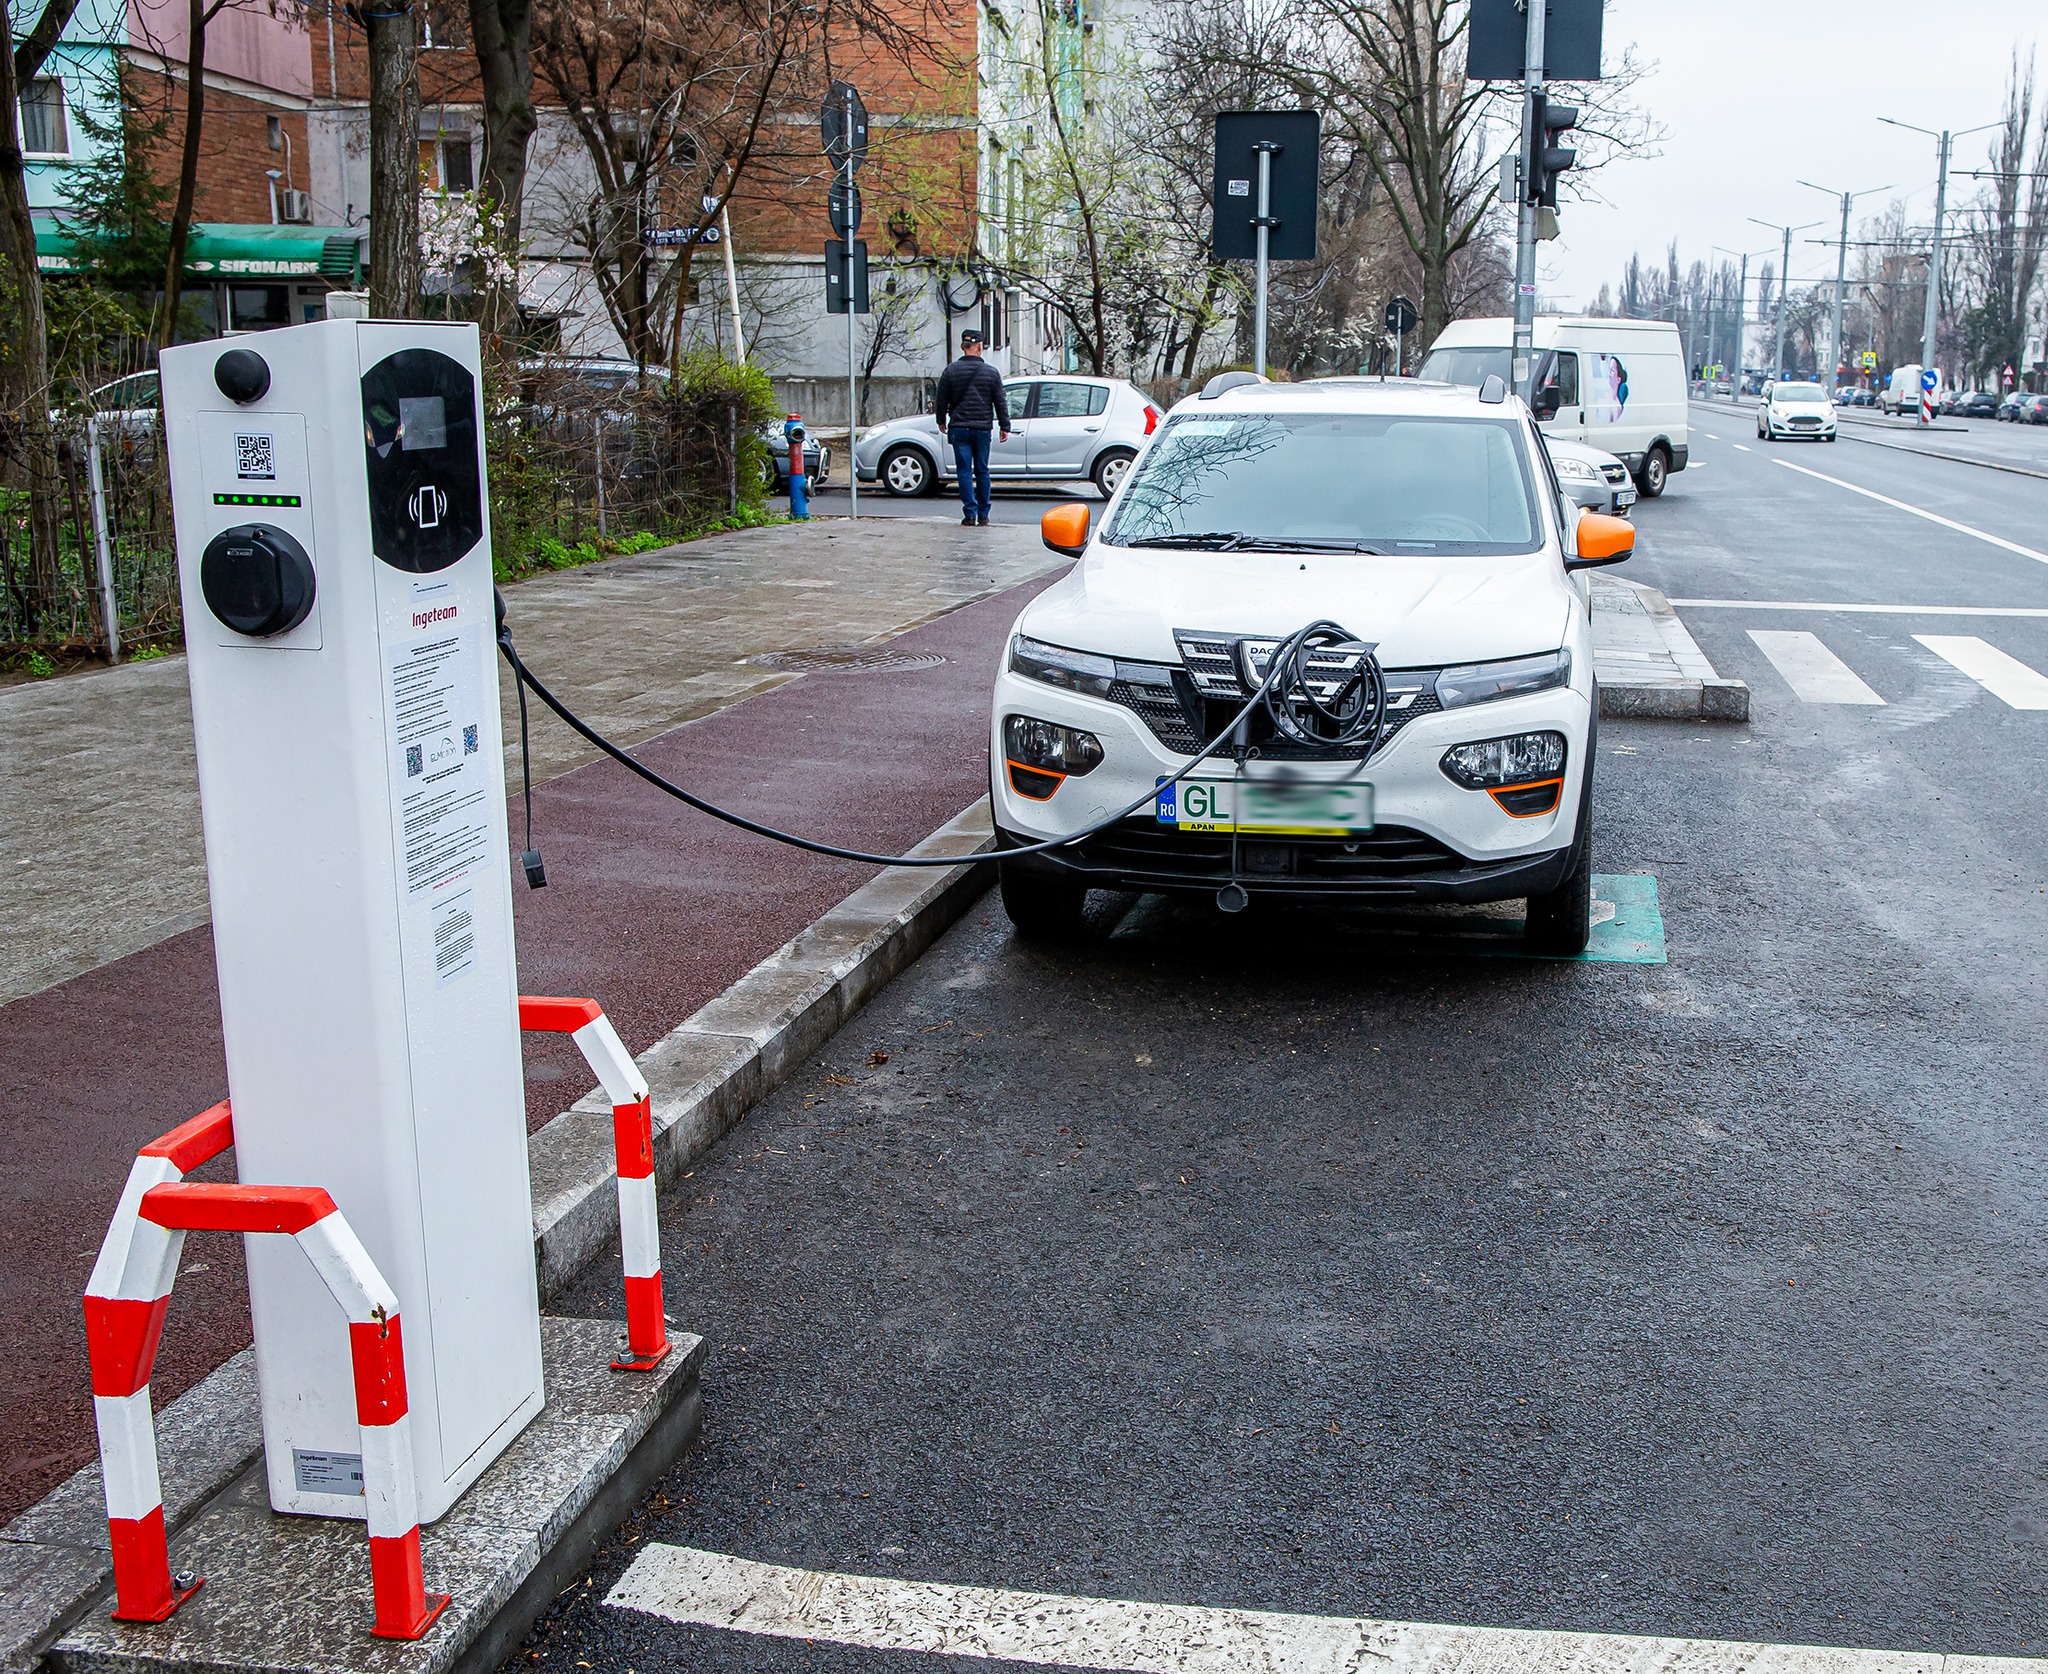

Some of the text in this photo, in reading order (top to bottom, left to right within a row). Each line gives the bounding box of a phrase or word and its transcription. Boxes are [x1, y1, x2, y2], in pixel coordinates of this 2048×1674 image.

[412, 605, 458, 630] Ingeteam
[1160, 803, 1175, 817] RO
[1183, 784, 1230, 819] GL
[1190, 823, 1215, 831] APAN
